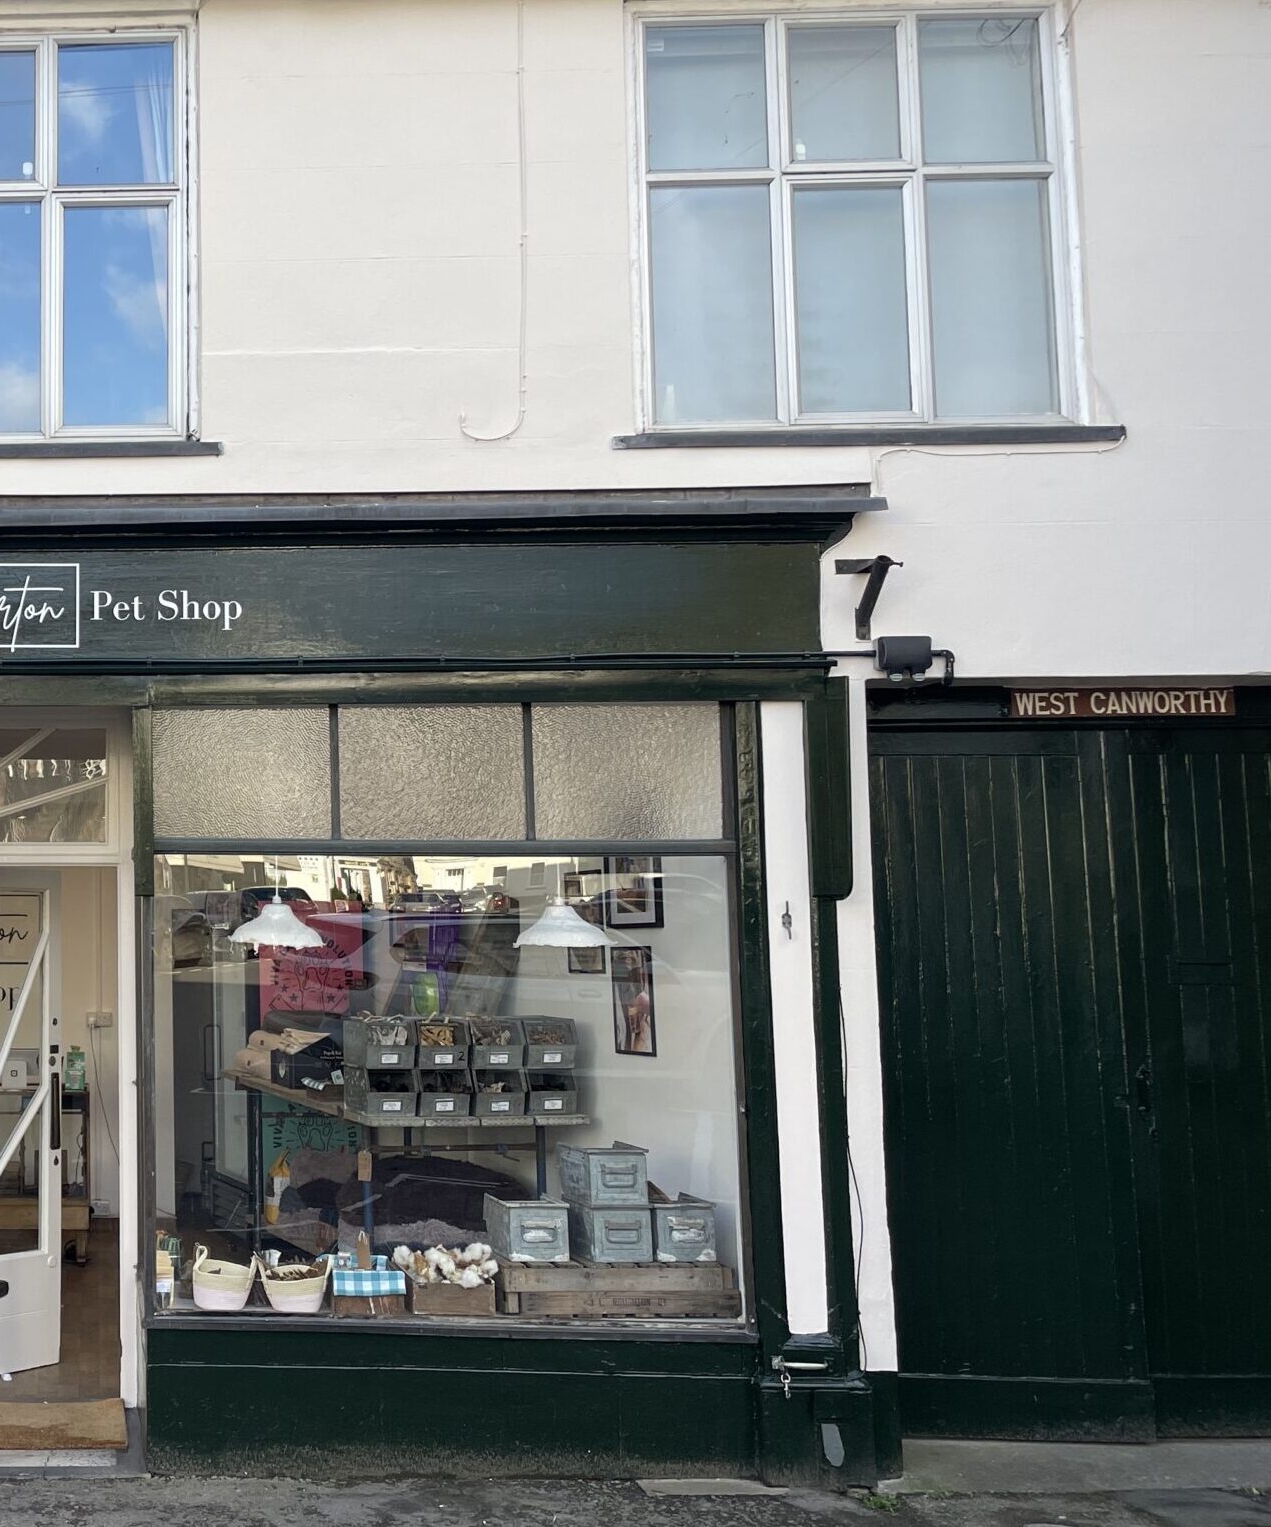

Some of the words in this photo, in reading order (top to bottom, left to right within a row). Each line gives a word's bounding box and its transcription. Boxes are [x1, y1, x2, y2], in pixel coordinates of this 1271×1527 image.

[89, 590, 146, 621] Pet
[157, 589, 243, 631] Shop
[1014, 692, 1079, 716] WEST
[1089, 689, 1230, 714] CANWORTHY
[458, 1051, 466, 1062] 2
